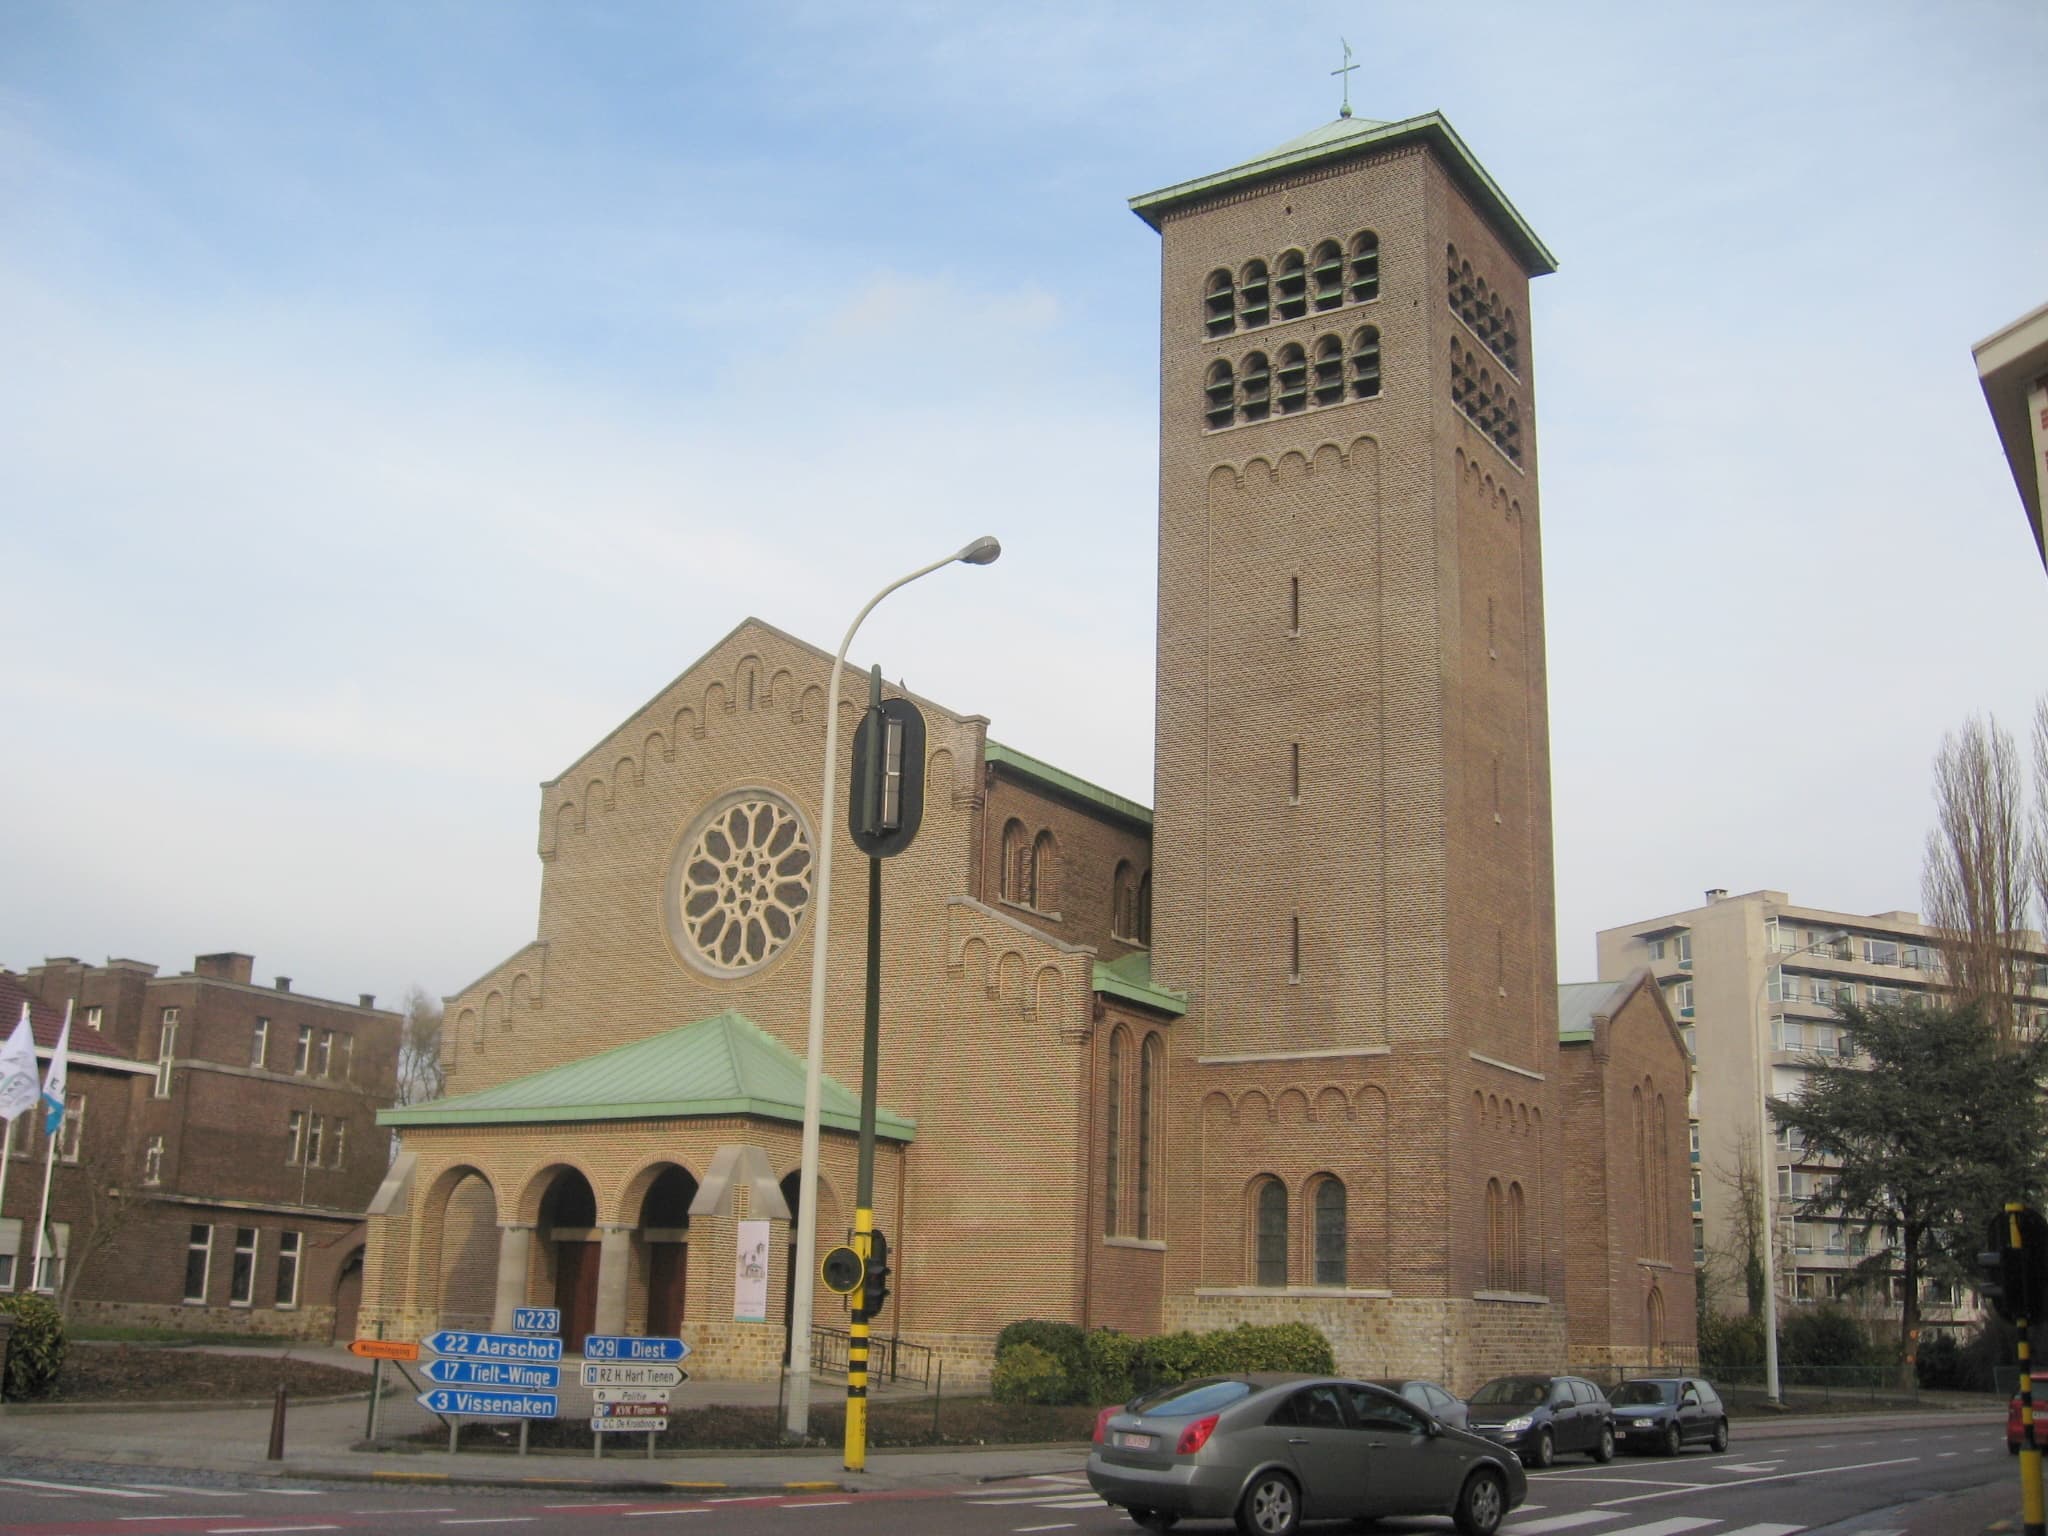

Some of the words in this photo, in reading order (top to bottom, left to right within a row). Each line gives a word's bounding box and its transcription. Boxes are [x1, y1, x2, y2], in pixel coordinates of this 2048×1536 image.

[517, 1311, 556, 1330] N223
[445, 1335, 469, 1353] 22
[476, 1337, 555, 1359] Aarschot
[588, 1339, 616, 1357] N29
[631, 1341, 667, 1358] Diest
[444, 1362, 459, 1380] 17
[469, 1363, 551, 1389] Tielt-Winge
[625, 1369, 644, 1382] Hart
[647, 1369, 675, 1384] Tienen
[437, 1393, 449, 1410] 3
[456, 1393, 552, 1415] Vissenaken
